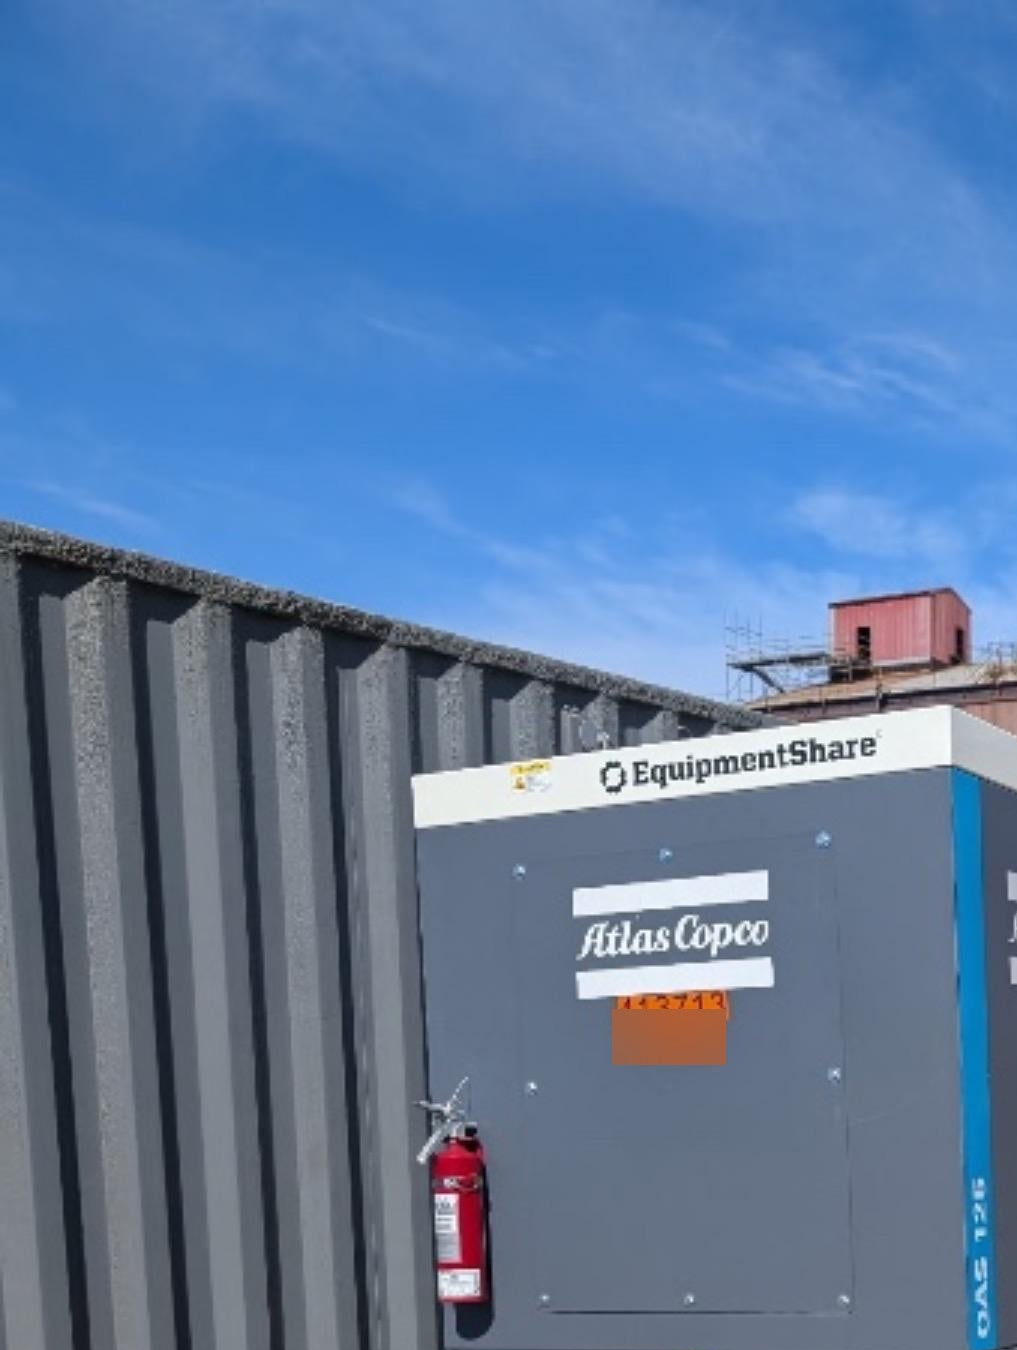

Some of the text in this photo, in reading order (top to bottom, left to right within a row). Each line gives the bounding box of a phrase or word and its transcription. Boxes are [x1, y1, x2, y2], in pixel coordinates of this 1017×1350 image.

[632, 736, 877, 788] EquipmentShare
[576, 914, 769, 960] Atlas Copco
